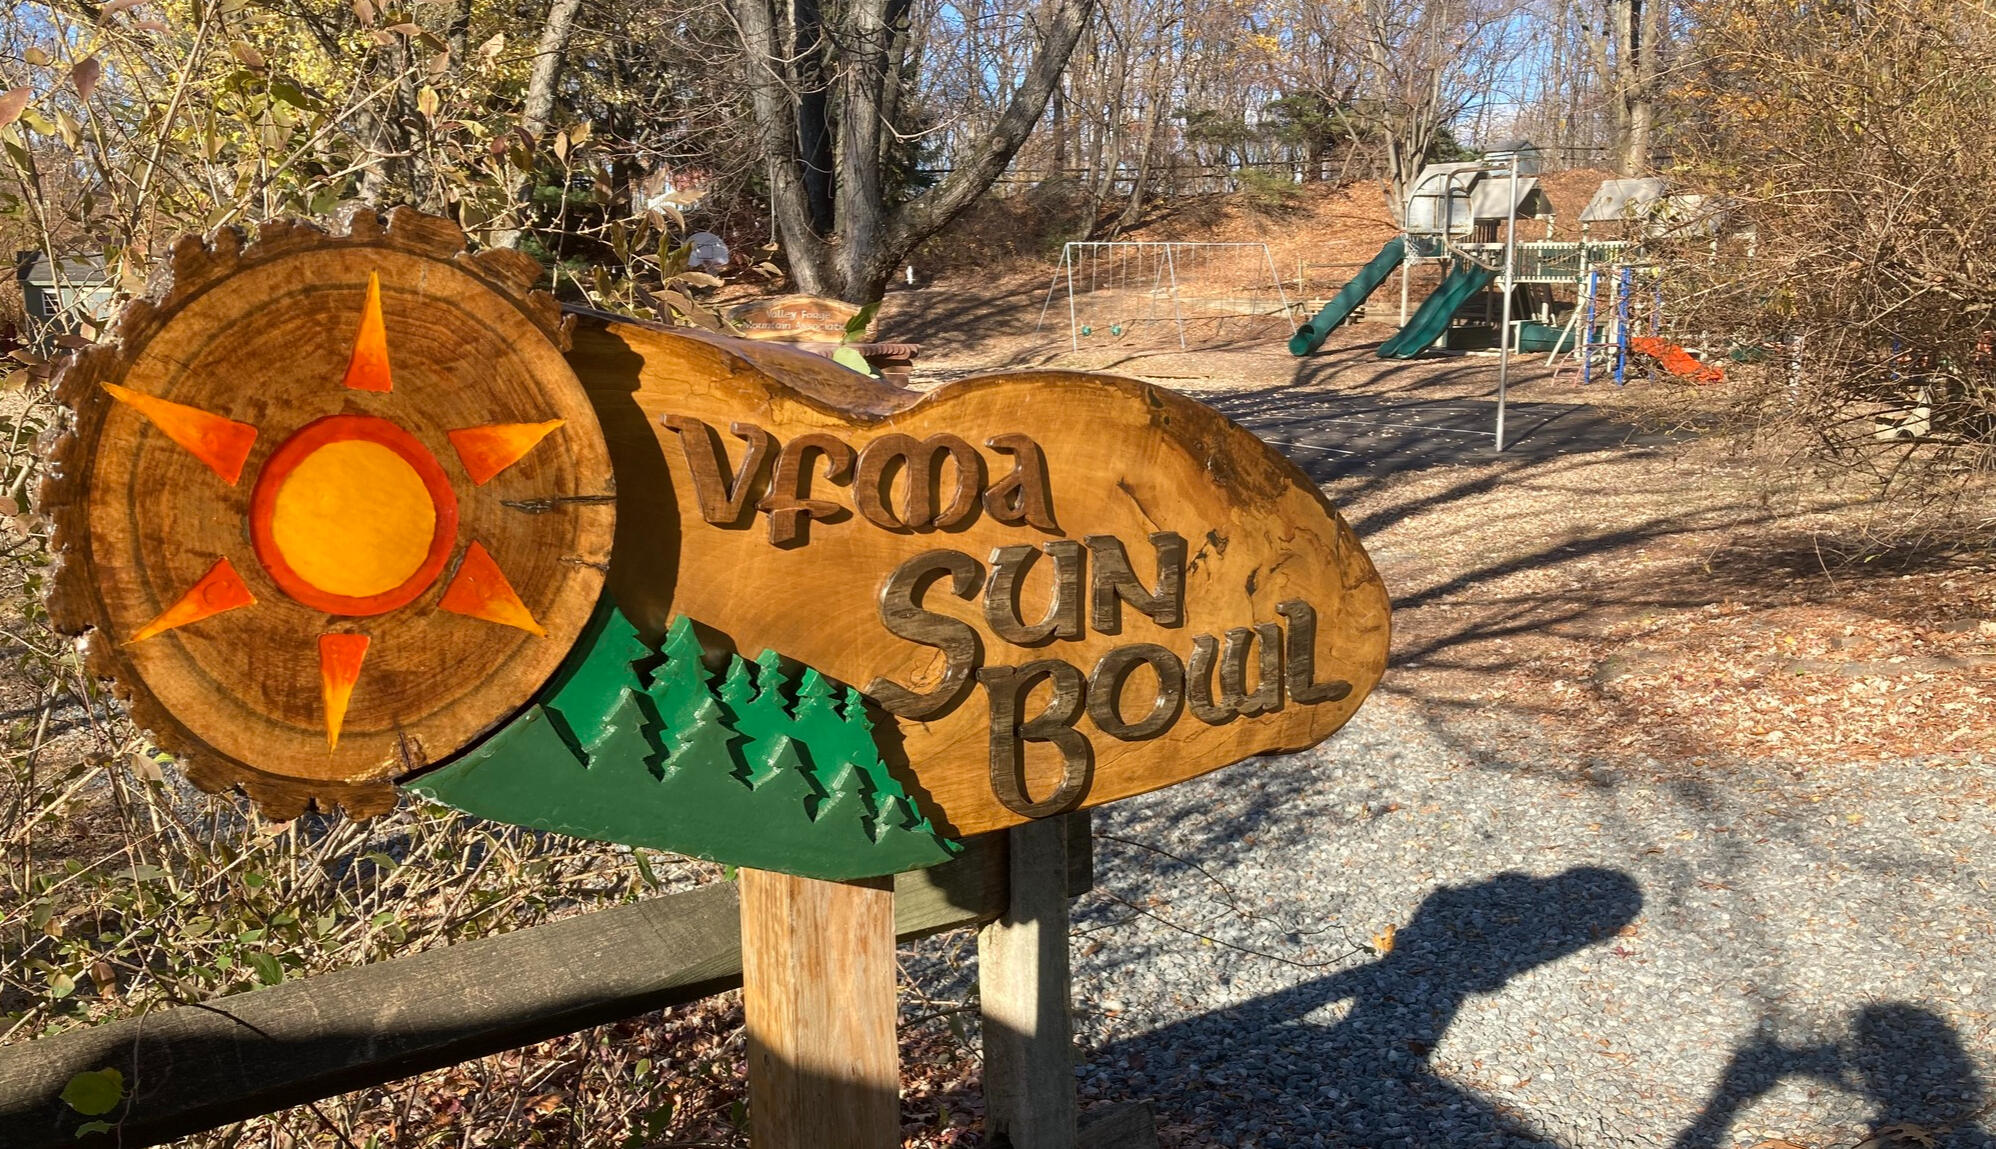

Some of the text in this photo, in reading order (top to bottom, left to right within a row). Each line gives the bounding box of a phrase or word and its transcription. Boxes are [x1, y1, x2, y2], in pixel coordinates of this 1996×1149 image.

[766, 309, 831, 321] Valley Forge
[743, 320, 791, 330] Mountain
